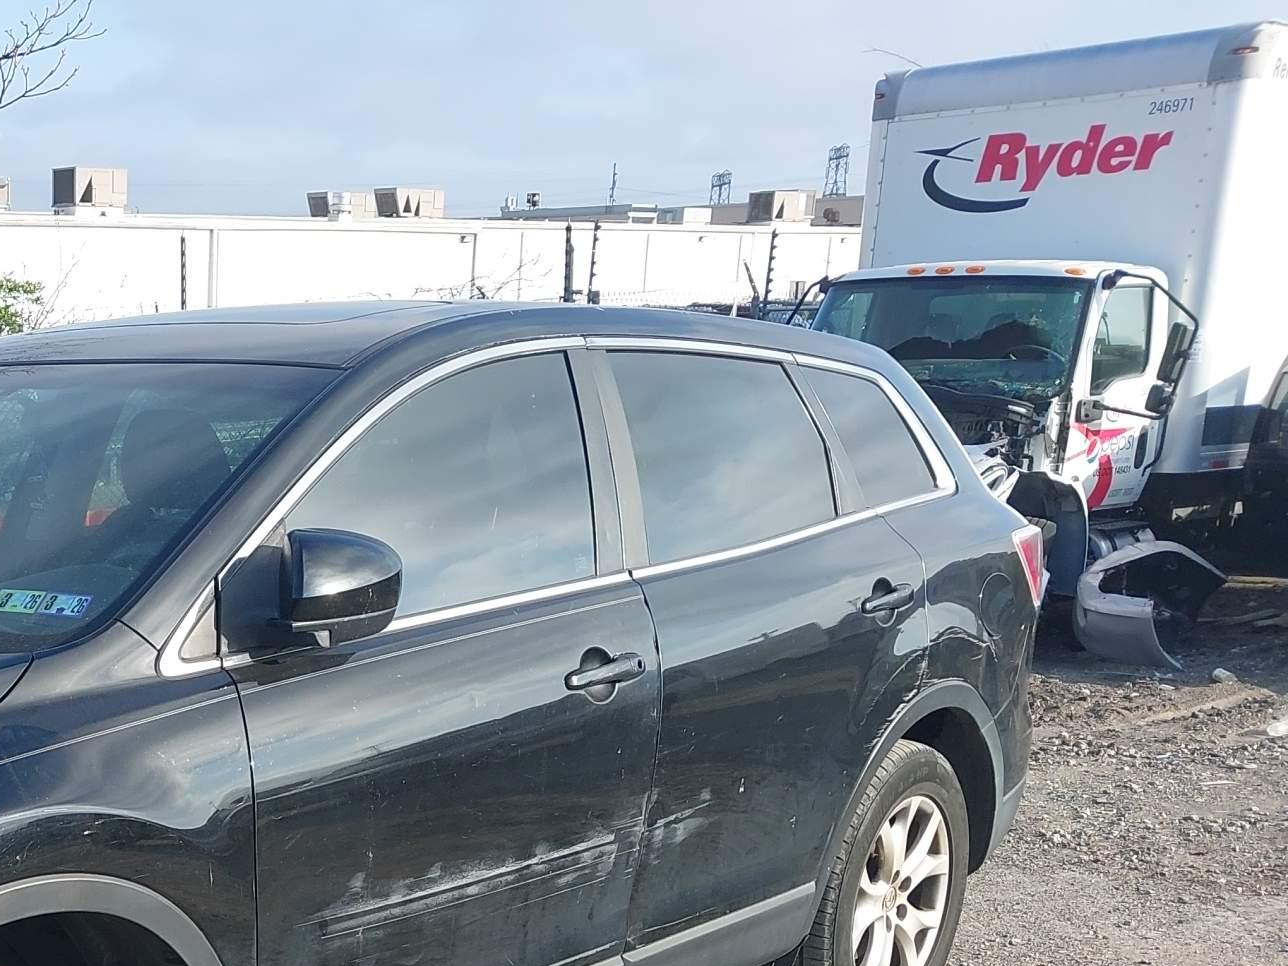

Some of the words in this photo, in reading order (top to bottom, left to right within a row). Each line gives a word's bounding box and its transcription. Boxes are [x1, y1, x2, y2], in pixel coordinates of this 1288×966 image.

[1148, 97, 1194, 115] 246971
[974, 124, 1175, 192] Ryder
[0, 593, 13, 608] 3
[44, 595, 58, 611] 3
